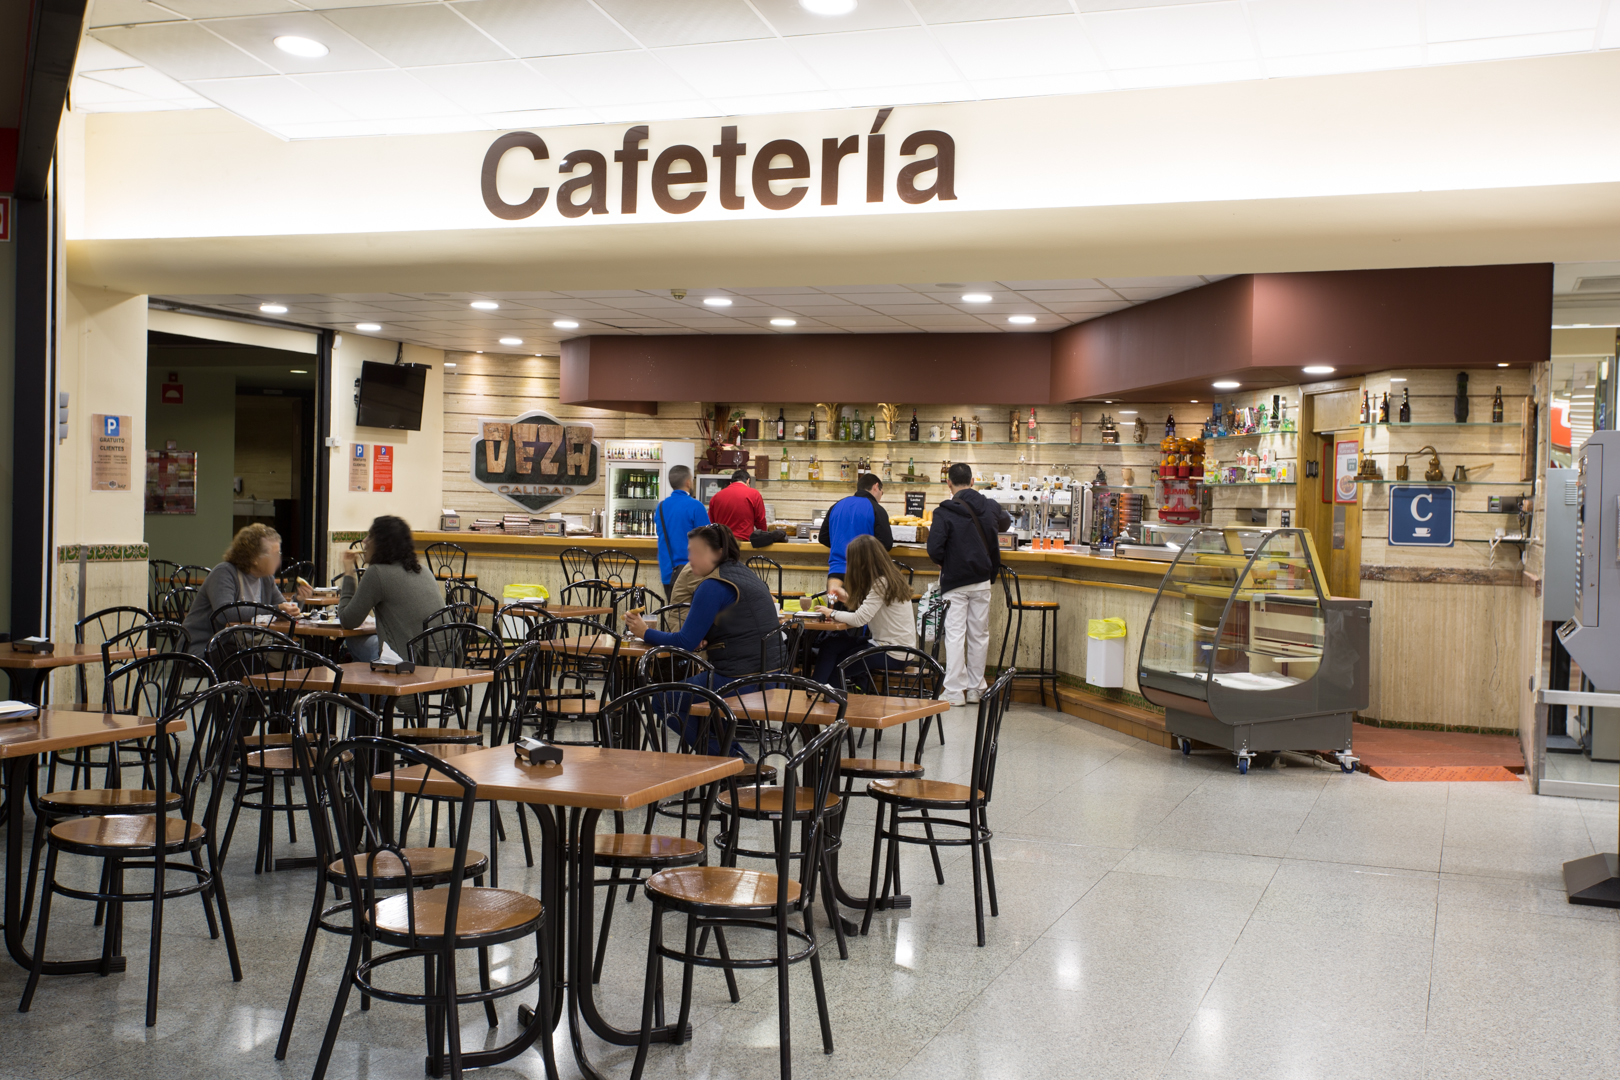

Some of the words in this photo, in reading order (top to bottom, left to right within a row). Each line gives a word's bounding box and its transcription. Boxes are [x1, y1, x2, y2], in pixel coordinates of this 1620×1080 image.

[480, 107, 958, 221] Cafetería
[108, 418, 116, 434] P
[357, 445, 363, 457] P
[482, 422, 594, 476] VEZA
[498, 485, 575, 496] CALIDAD
[1409, 493, 1433, 522] C
